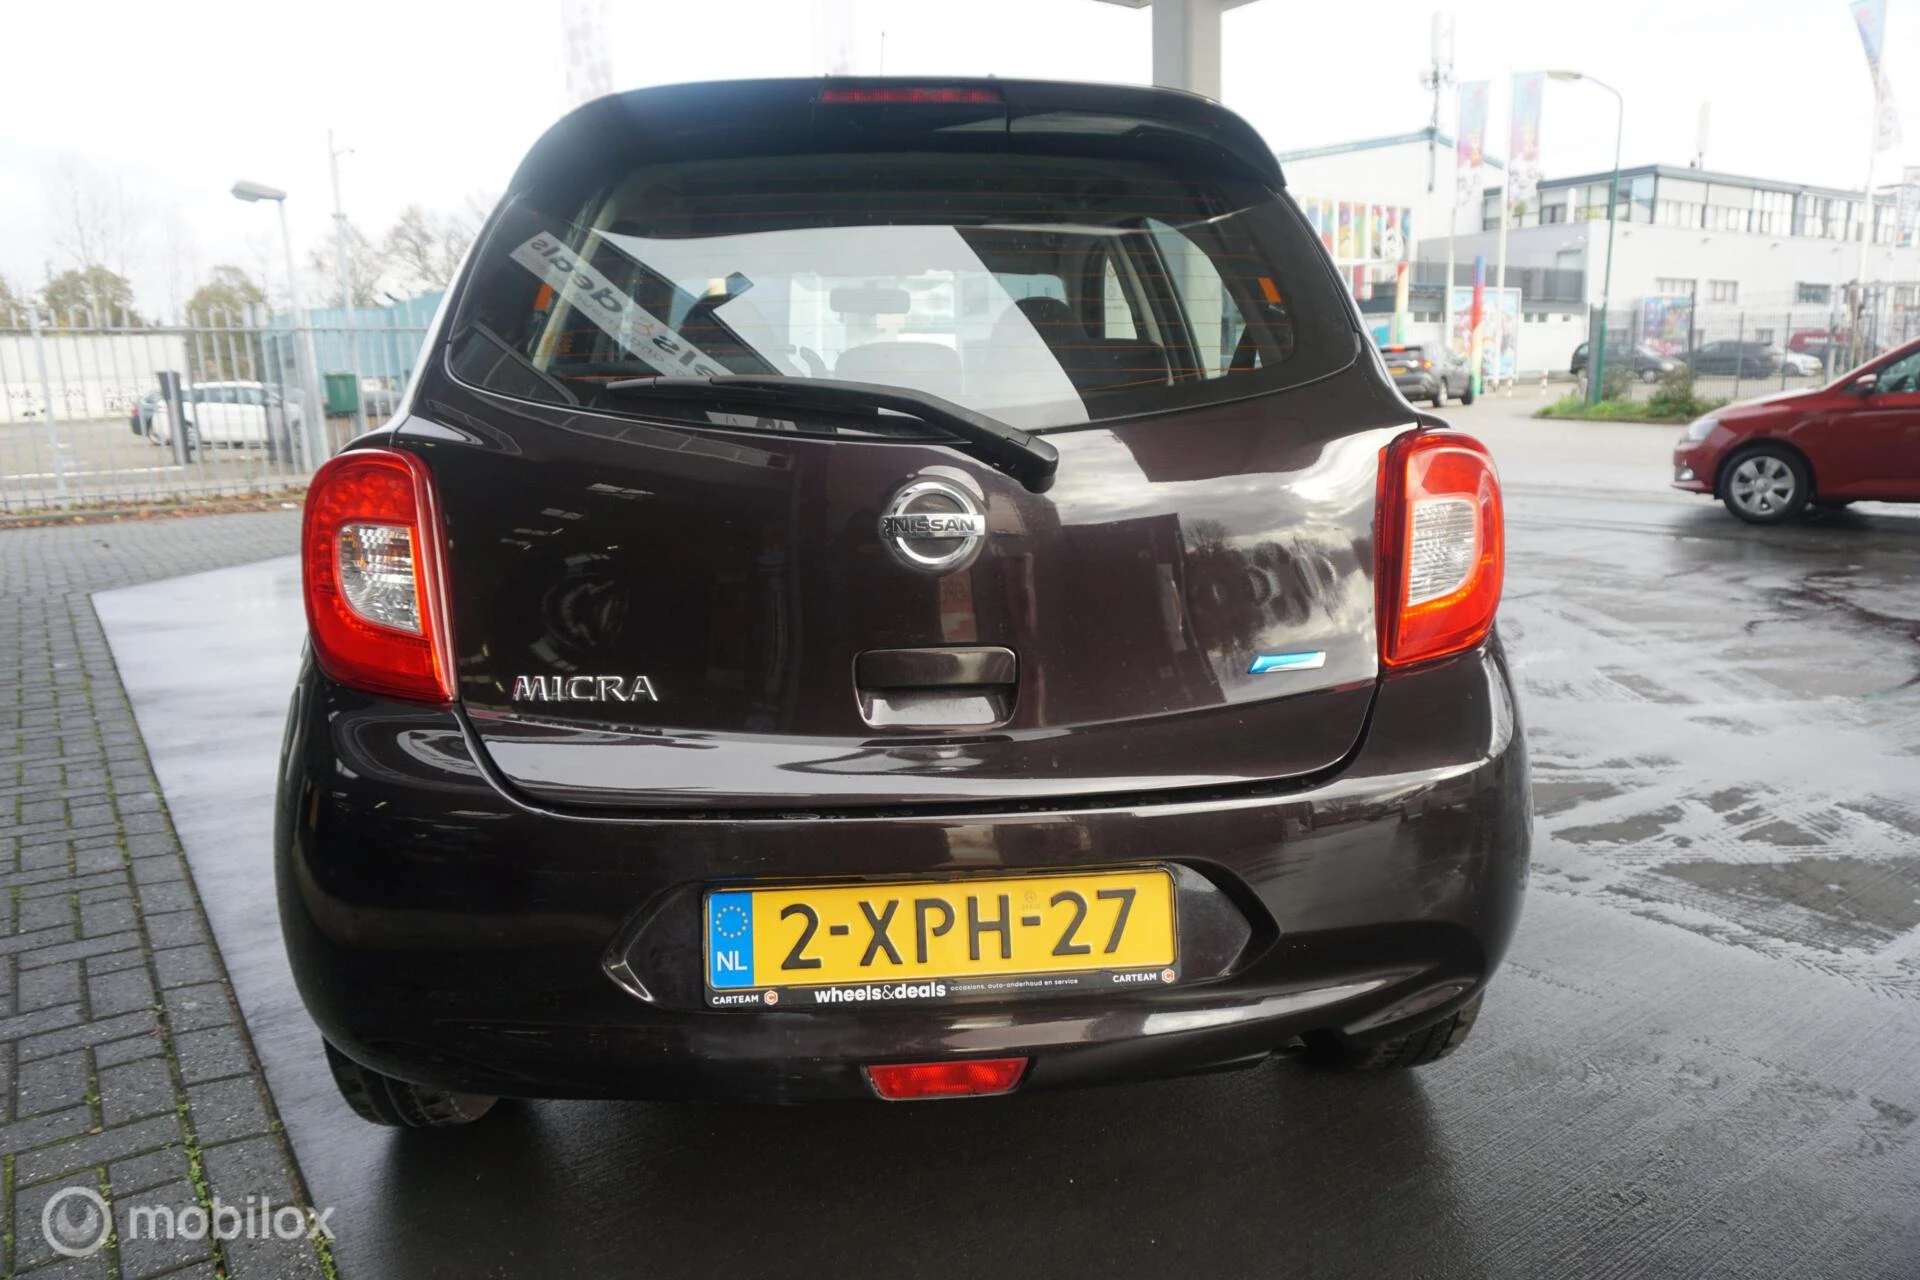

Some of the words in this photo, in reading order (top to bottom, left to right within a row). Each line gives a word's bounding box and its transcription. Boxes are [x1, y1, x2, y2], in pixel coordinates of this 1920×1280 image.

[892, 519, 975, 532] NISSAN
[512, 675, 659, 702] MICRA
[780, 888, 1137, 971] 2-XPH-27
[716, 950, 748, 972] NL
[1112, 972, 1157, 983] CARTEAM
[712, 994, 759, 1005] CARTEAM
[814, 982, 946, 1003] wheels&deals
